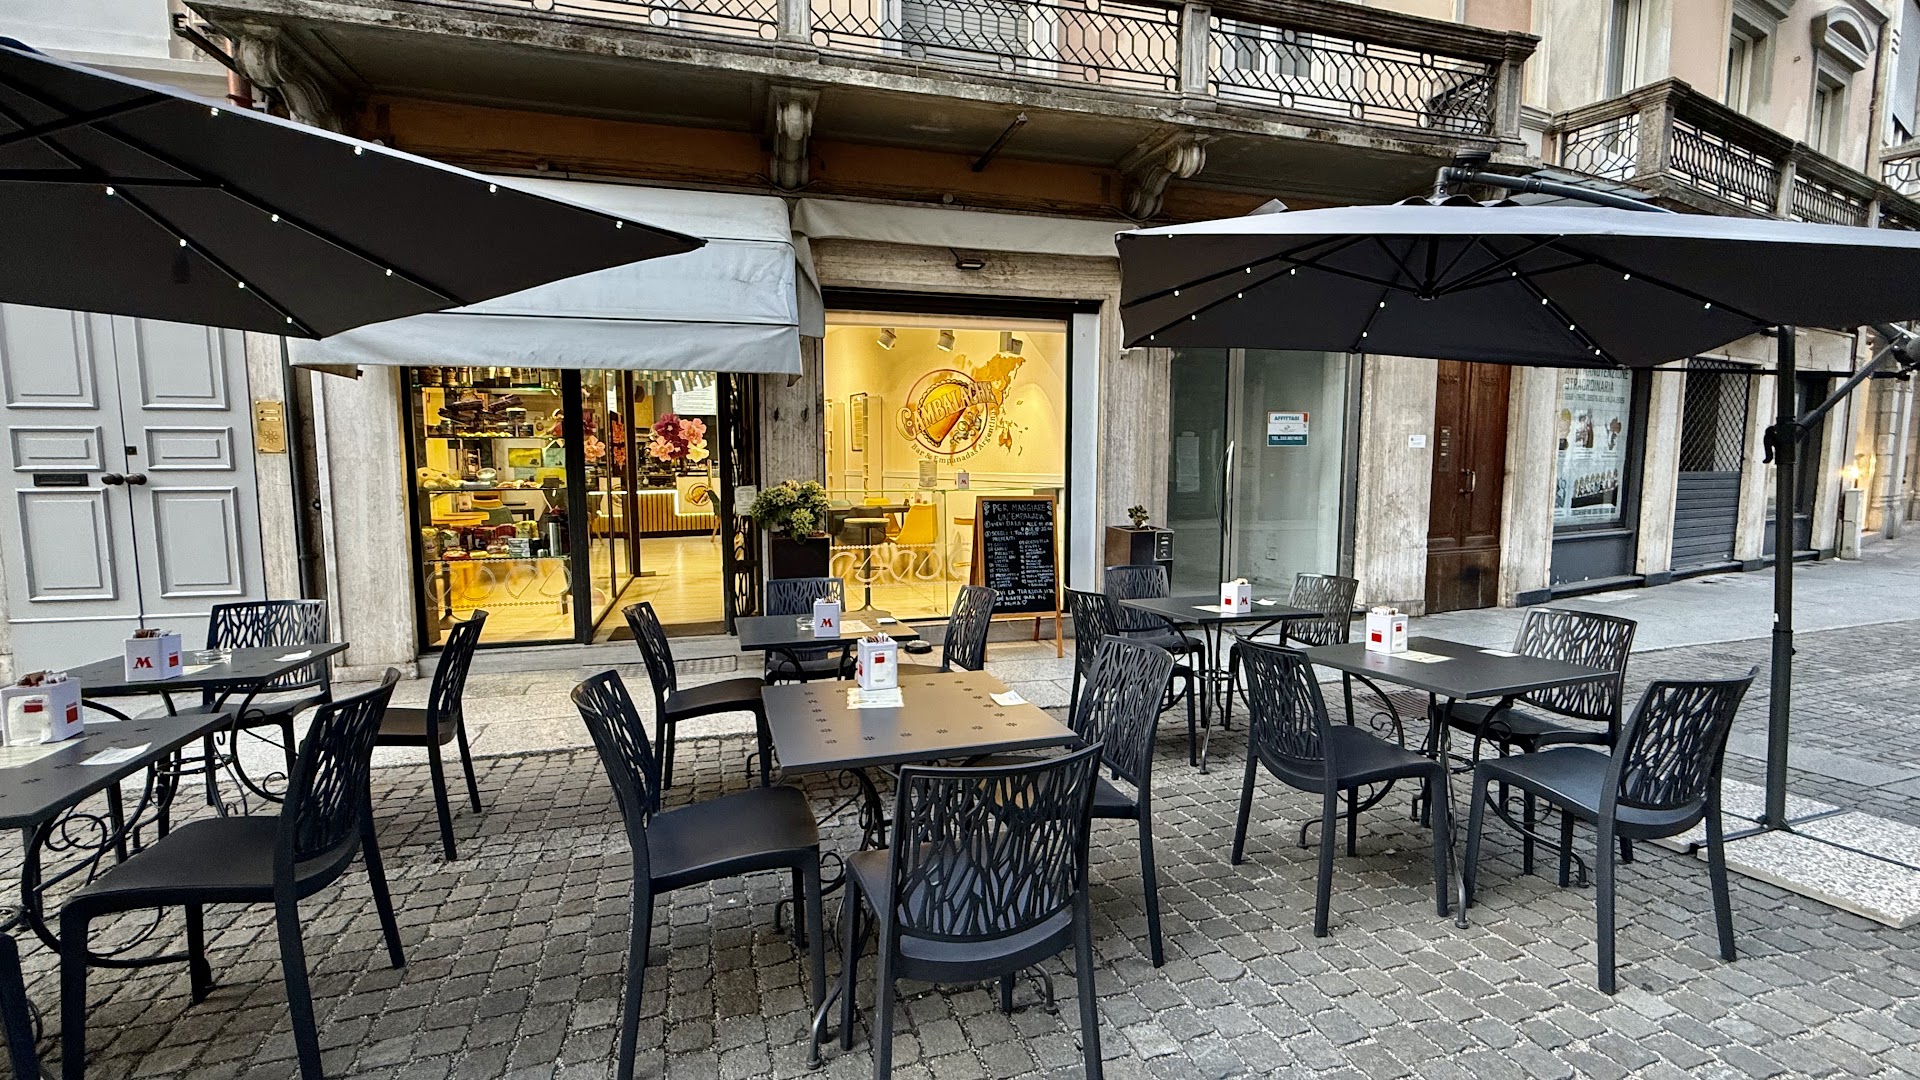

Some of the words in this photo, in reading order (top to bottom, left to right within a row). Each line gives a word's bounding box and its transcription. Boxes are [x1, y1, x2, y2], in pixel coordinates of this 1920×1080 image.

[1565, 378, 1614, 393] STRAORDINARIA
[896, 381, 996, 441] CAMBALACHE
[911, 443, 924, 456] Bar
[934, 449, 978, 465] Empanadas
[992, 503, 1008, 514] PER
[1011, 504, 1046, 512] MANGIARE
[820, 618, 833, 627] M
[133, 656, 153, 669] M
